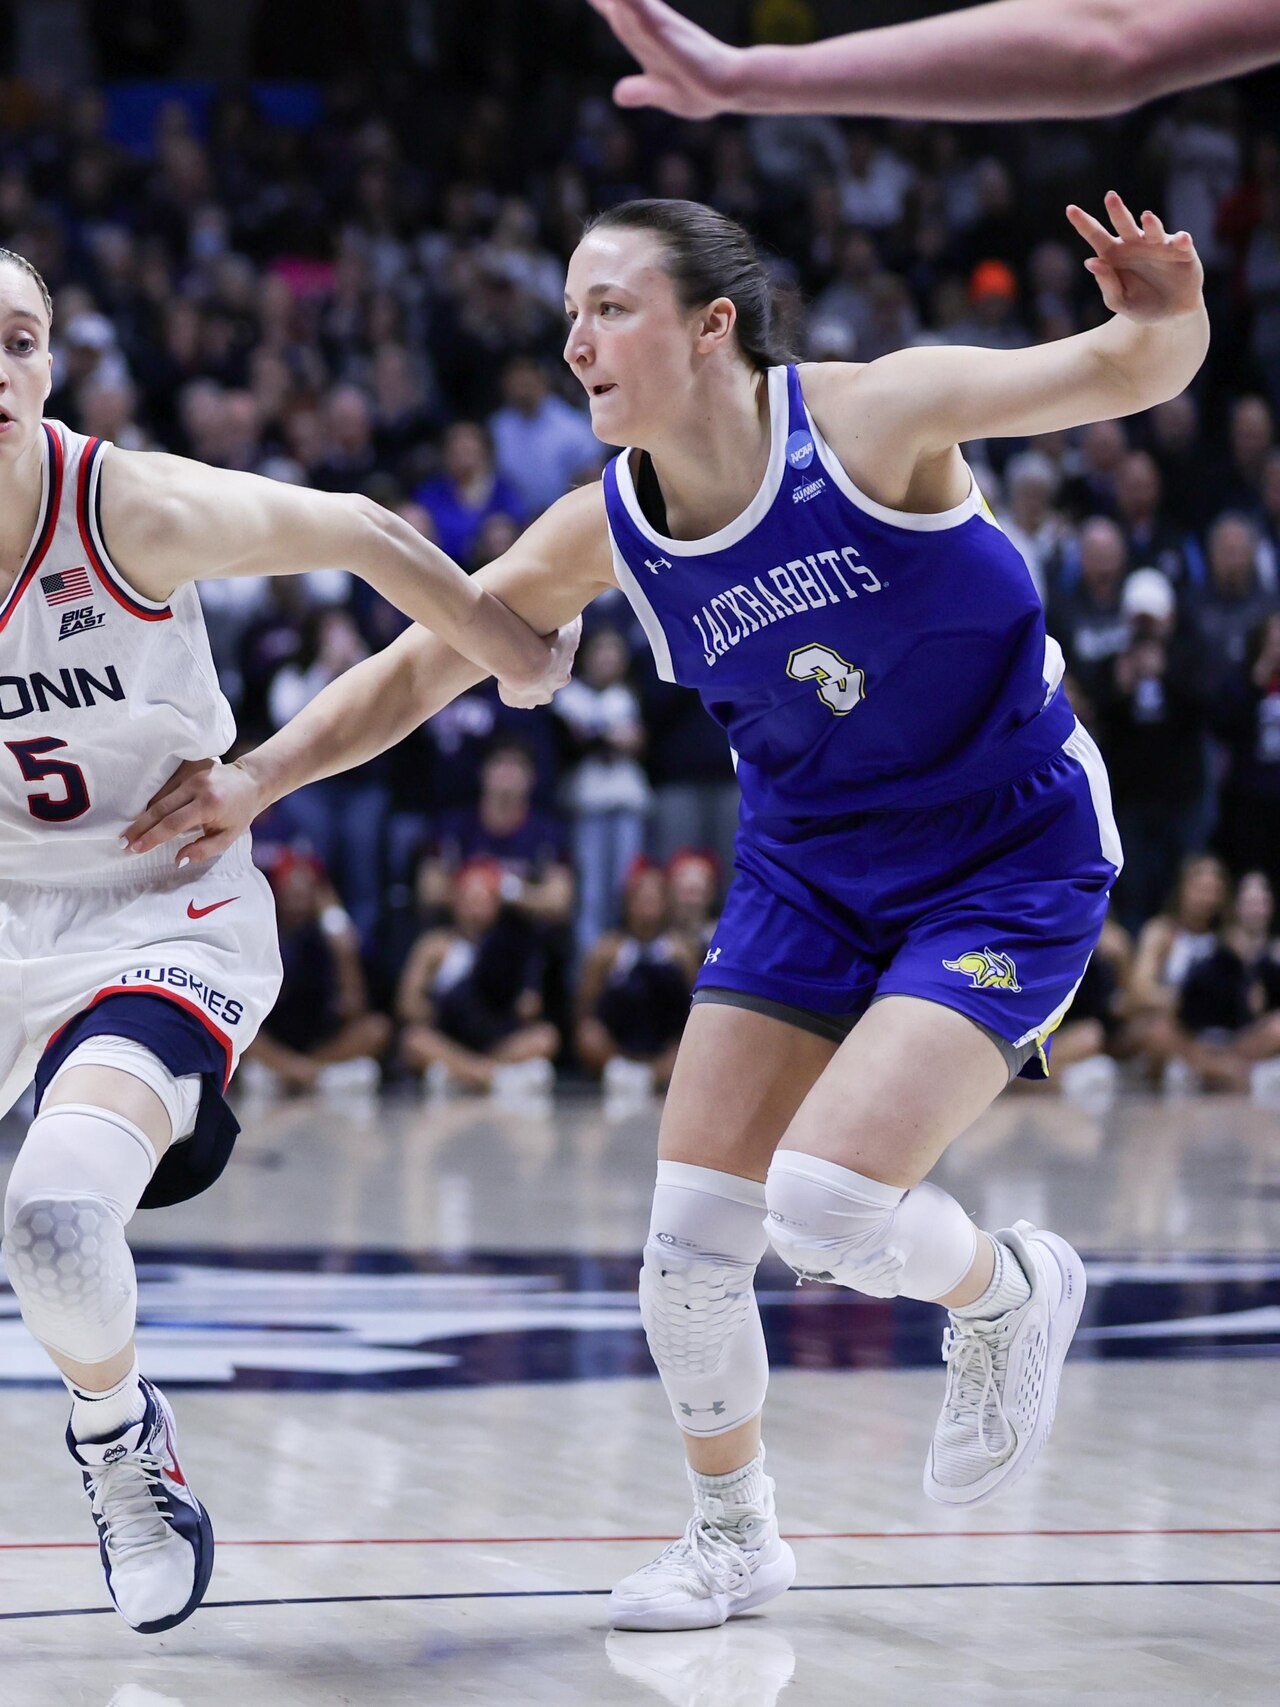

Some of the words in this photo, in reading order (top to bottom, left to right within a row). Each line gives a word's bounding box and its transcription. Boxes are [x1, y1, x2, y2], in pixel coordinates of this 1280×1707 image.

[790, 442, 813, 464] NCAA
[792, 478, 826, 504] SUMMIT
[61, 605, 94, 624] BIG
[692, 546, 882, 667] JACKRABBITS
[59, 612, 106, 635] EAST
[785, 642, 866, 717] 3
[3, 736, 91, 823] 5
